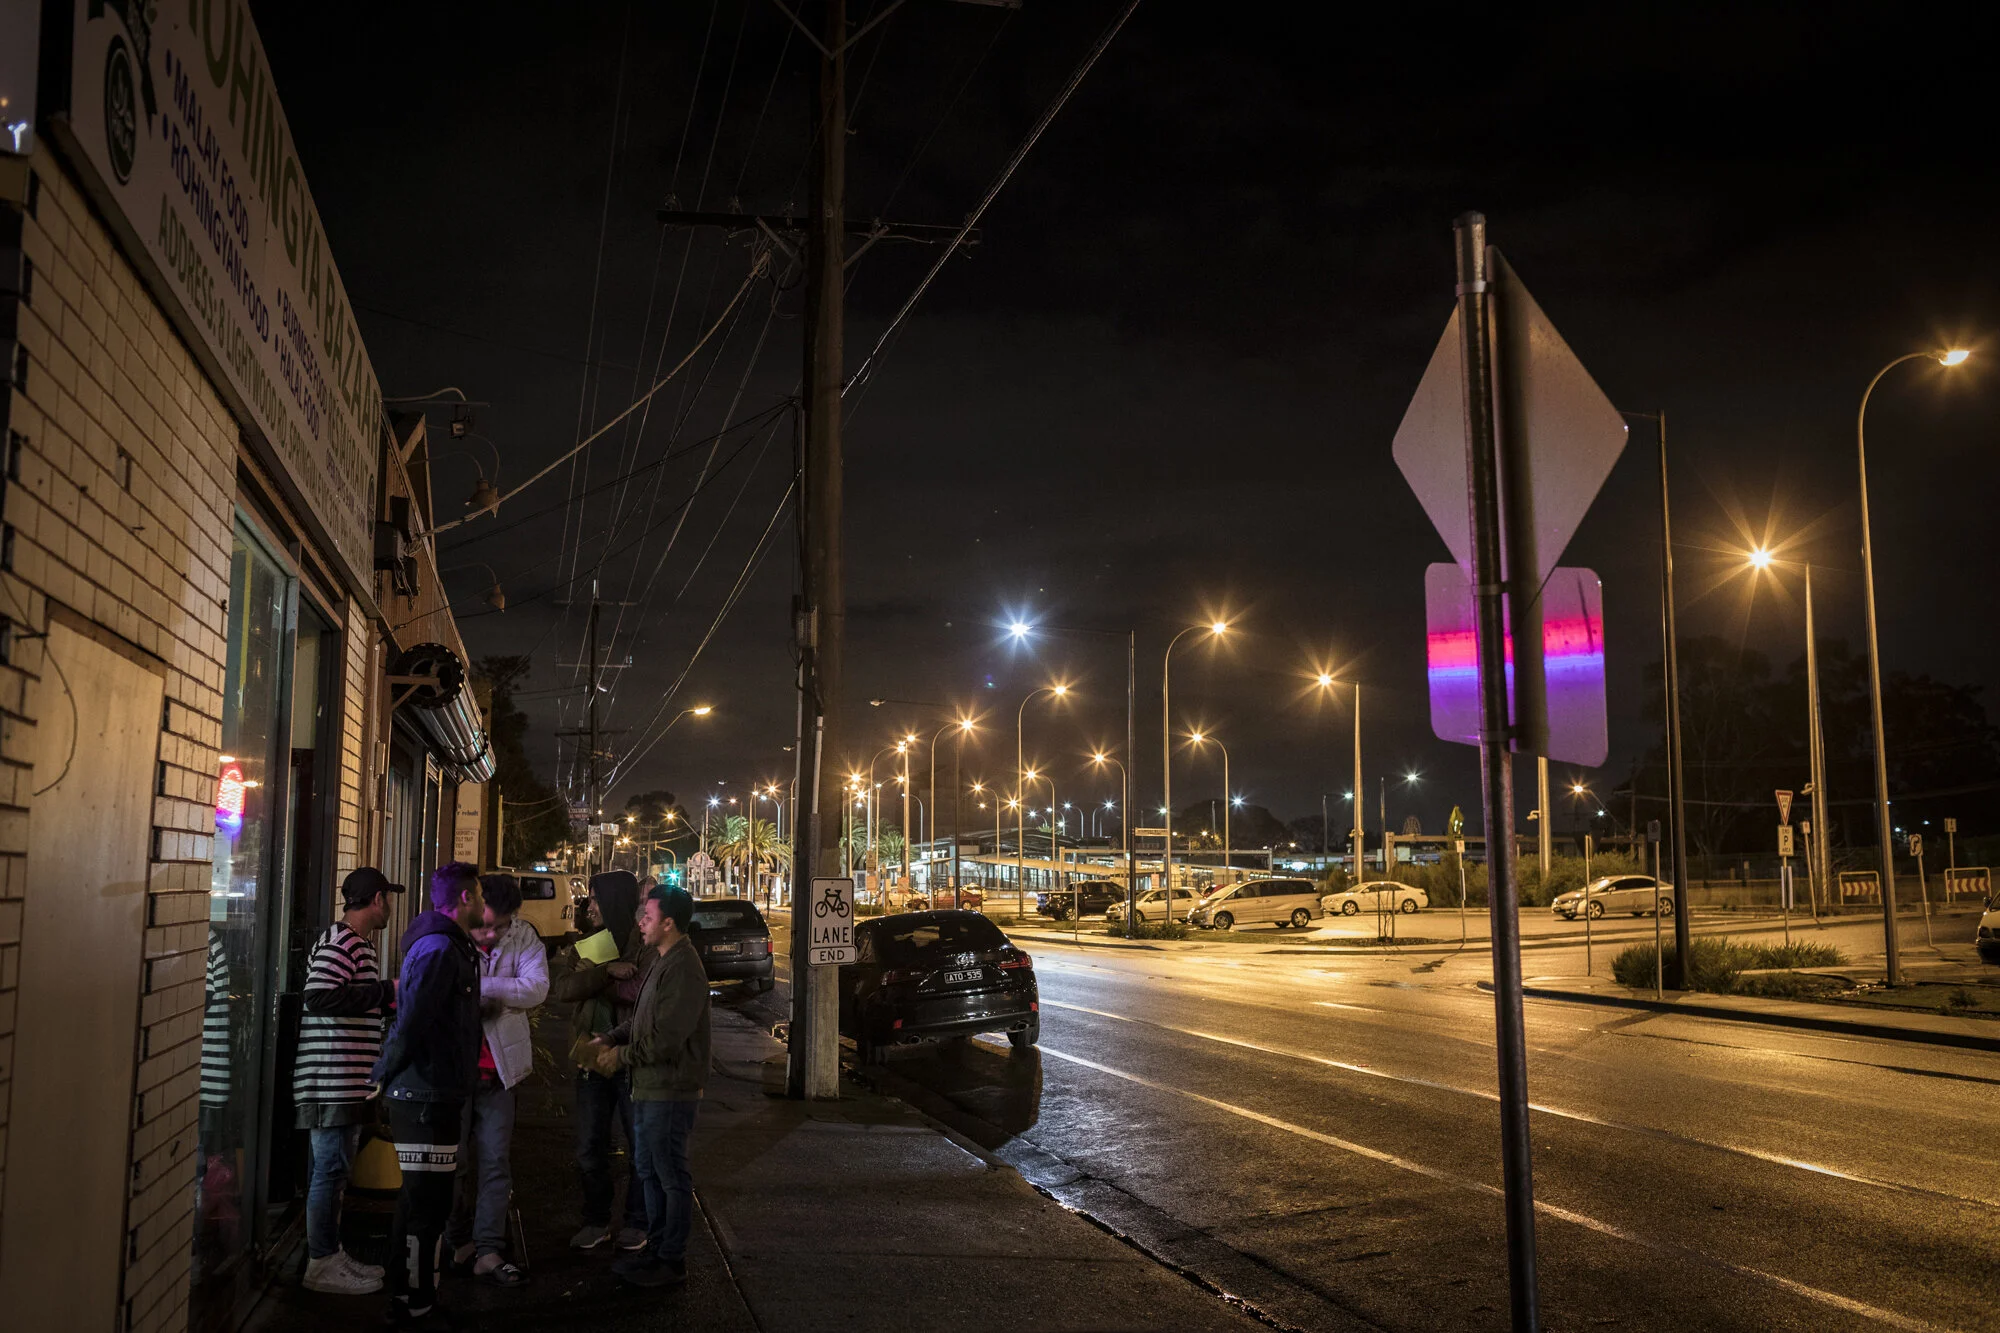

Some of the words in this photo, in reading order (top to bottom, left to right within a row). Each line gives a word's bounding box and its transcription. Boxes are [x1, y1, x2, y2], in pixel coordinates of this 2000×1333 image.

[174, 57, 220, 183] MALAY
[220, 157, 249, 249] FOOD
[171, 122, 242, 296] ROHINGYAN
[243, 267, 269, 343] FOOD
[189, 0, 320, 331] OHINGYA
[324, 264, 381, 466] BAZAAR
[158, 192, 217, 336] ADDRESS:
[218, 298, 225, 348] 8
[226, 309, 277, 431] LIGHTWOOD
[283, 291, 315, 382] BURMESE
[313, 360, 328, 415] FOOD
[280, 338, 302, 409] HALAL
[303, 387, 319, 441] FOOD
[327, 388, 369, 507] RESTAURANT
[814, 927, 849, 943] LANE
[820, 950, 845, 961] END
